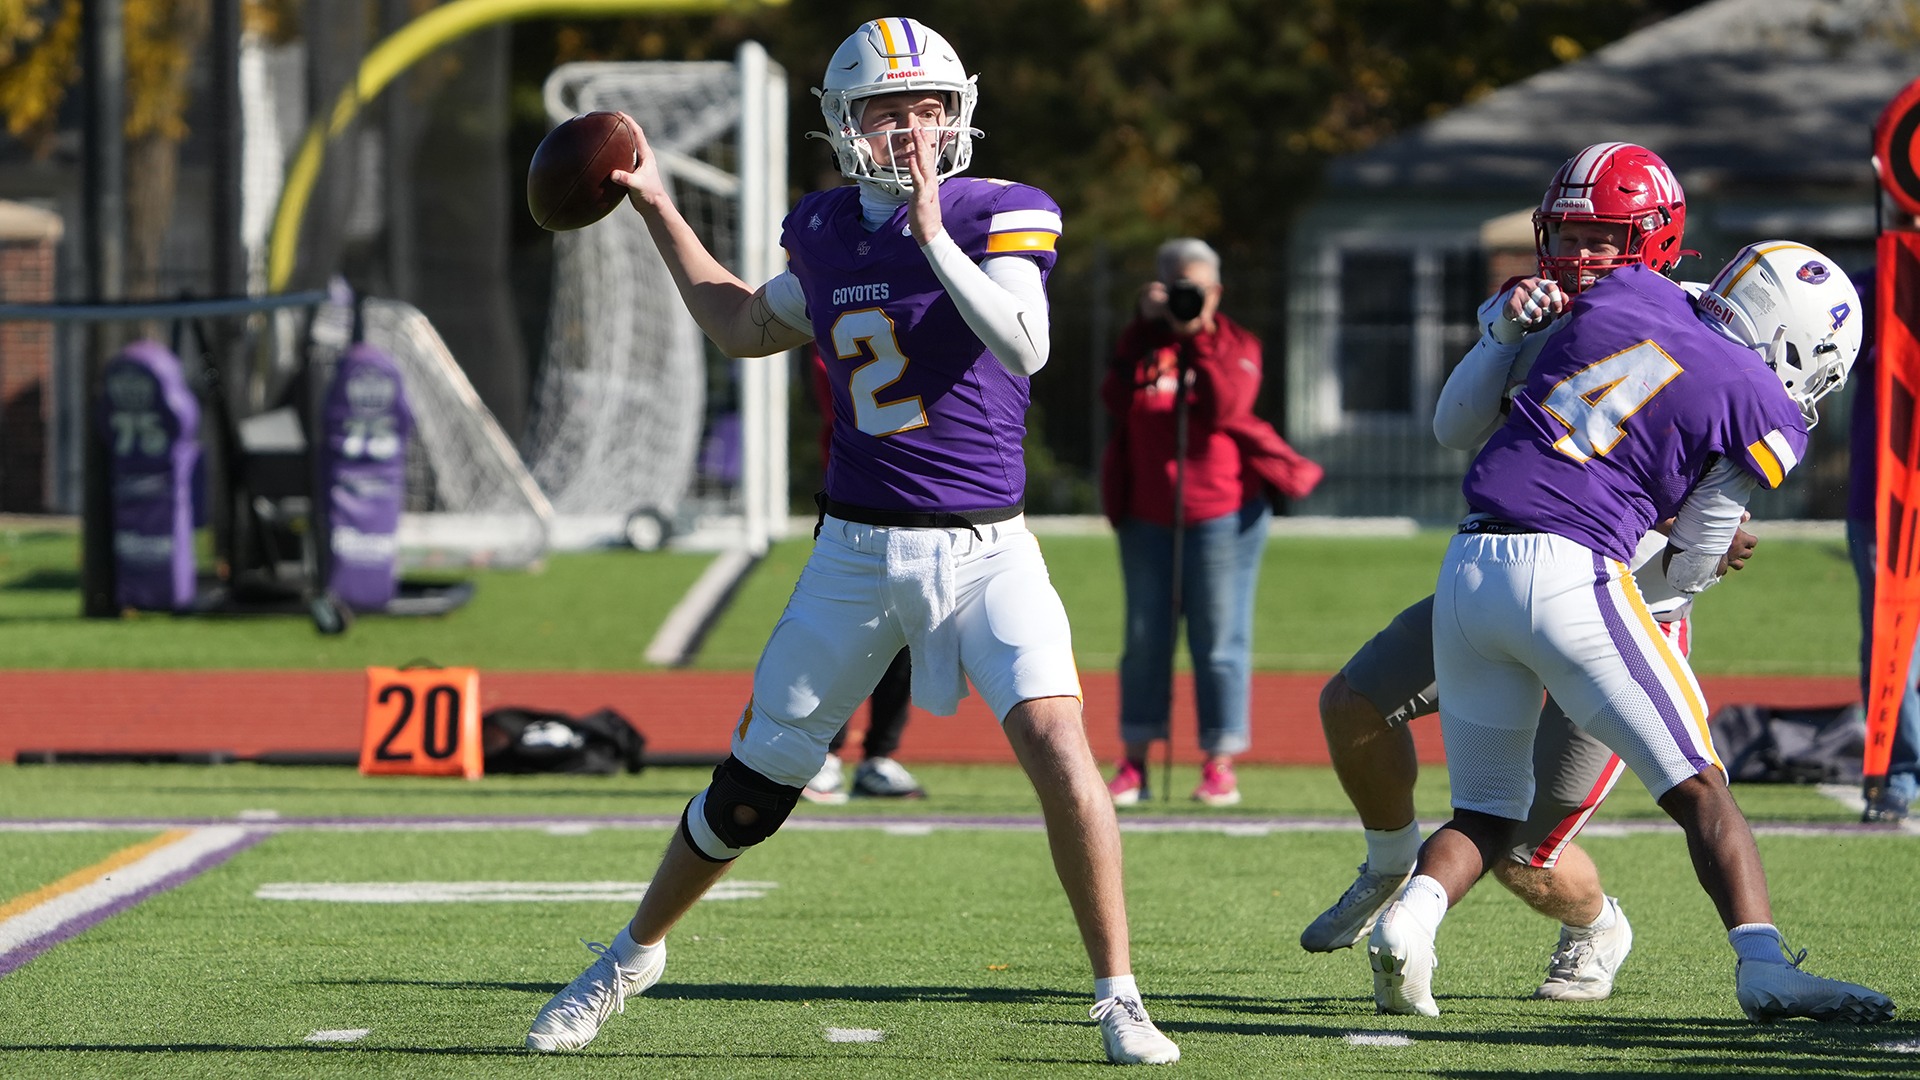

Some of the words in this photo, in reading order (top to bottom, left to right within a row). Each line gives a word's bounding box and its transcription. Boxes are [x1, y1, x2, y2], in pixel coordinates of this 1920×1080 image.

[1643, 165, 1682, 203] M
[832, 283, 890, 306] COYOTES
[1828, 301, 1852, 333] 4
[830, 306, 929, 438] 2
[1540, 338, 1684, 463] 4
[110, 411, 169, 457] 75
[342, 416, 402, 460] 75
[1874, 612, 1904, 748] FISHER
[376, 685, 461, 761] 20
